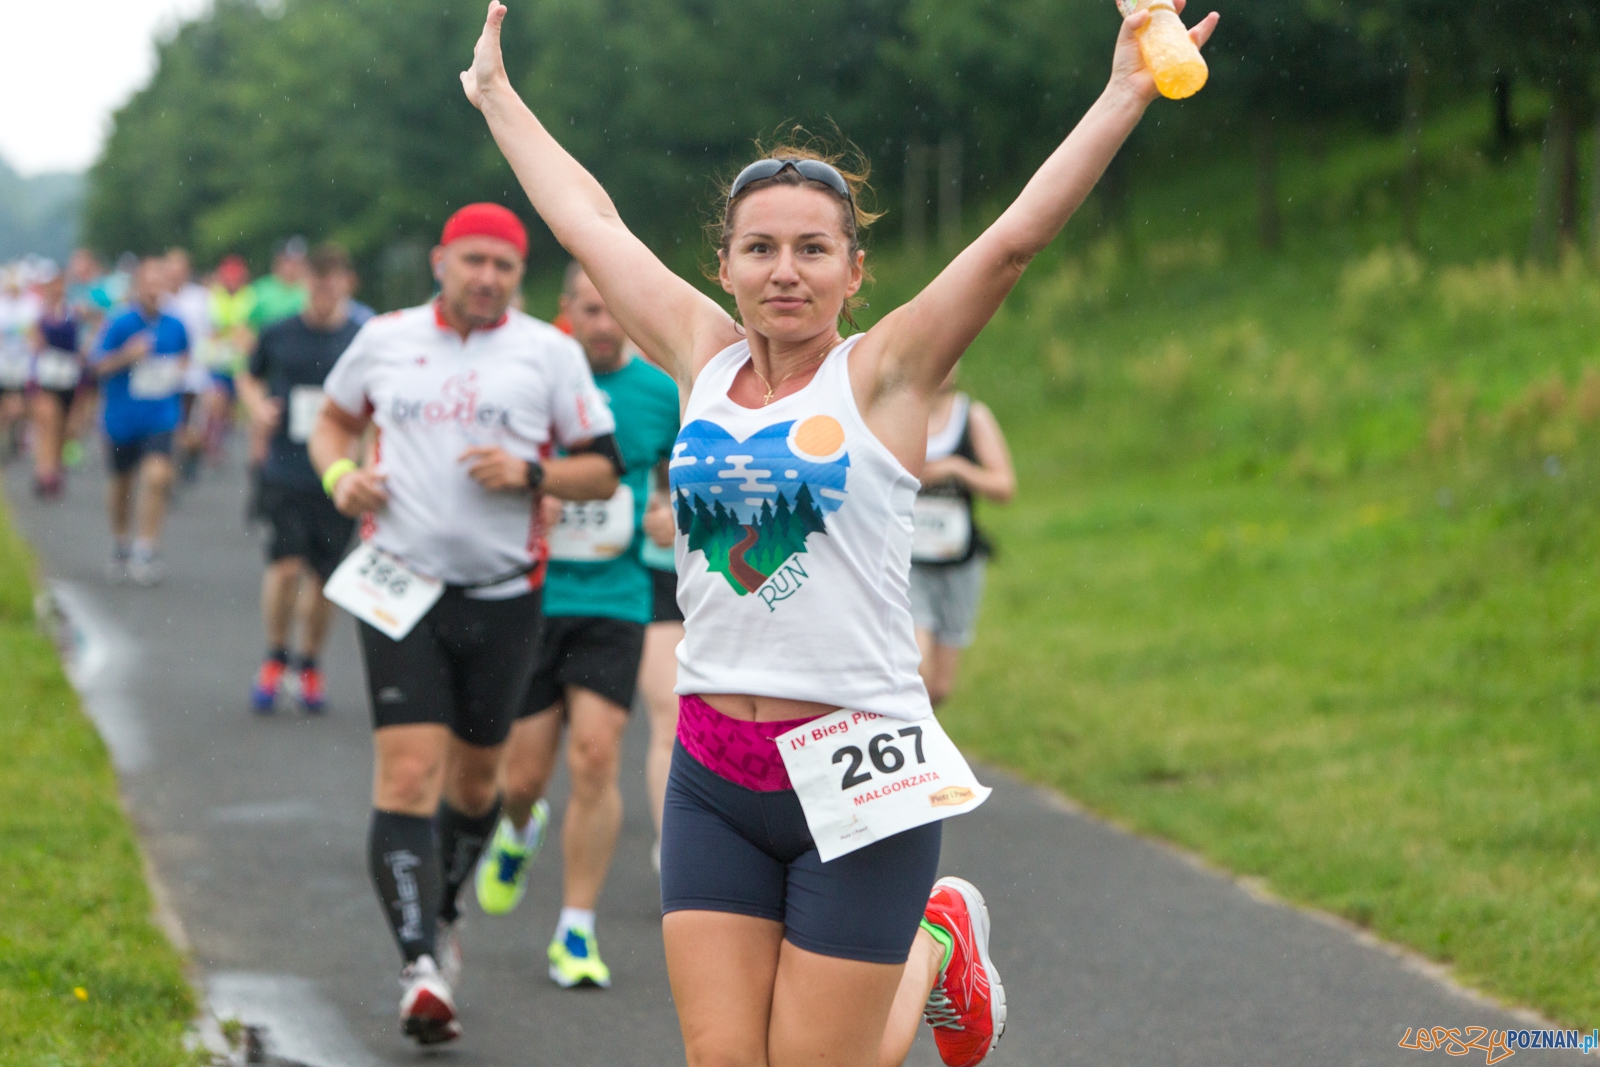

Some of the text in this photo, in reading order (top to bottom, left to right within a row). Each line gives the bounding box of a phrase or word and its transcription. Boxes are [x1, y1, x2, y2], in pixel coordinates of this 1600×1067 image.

[757, 555, 809, 612] RUN
[790, 711, 887, 751] IV Bieg Pio
[831, 725, 926, 791] 267
[853, 771, 940, 807] MAŁGORZATA
